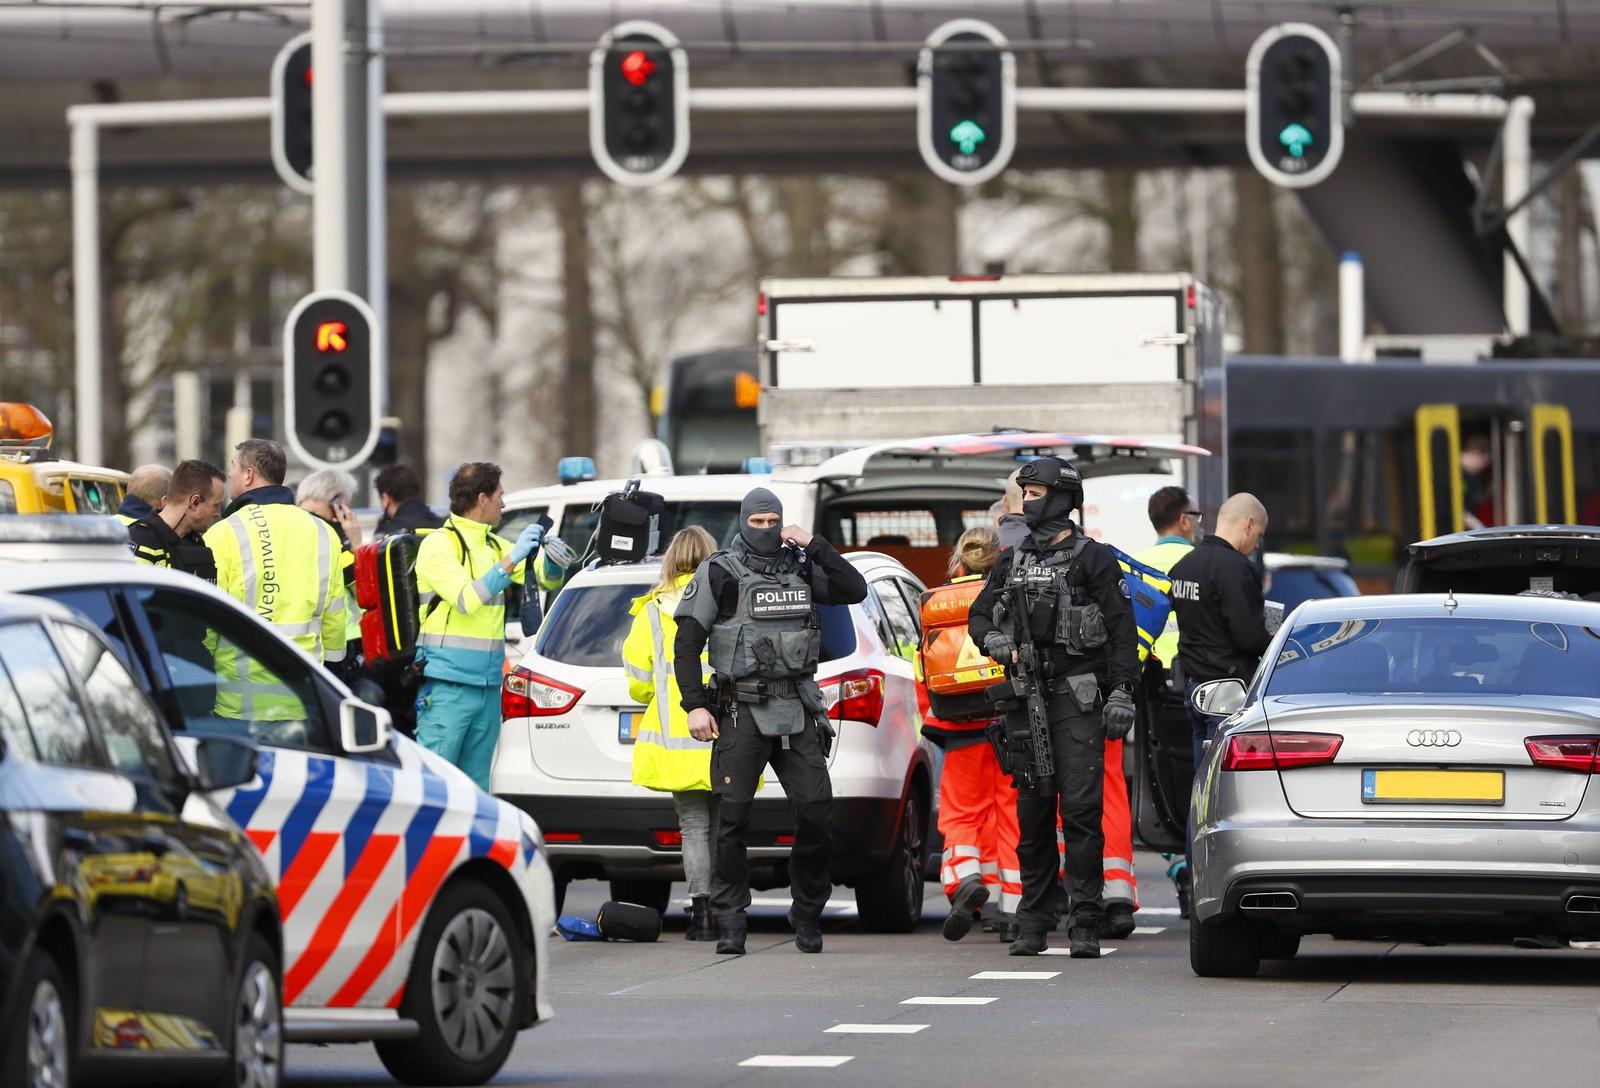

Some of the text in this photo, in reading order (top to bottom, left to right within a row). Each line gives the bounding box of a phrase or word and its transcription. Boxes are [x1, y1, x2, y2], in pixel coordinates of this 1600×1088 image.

[248, 504, 280, 623] Wegenwacht
[756, 590, 807, 603] POLITIE
[535, 722, 571, 730] SUZUKI
[1364, 786, 1374, 794] NL
